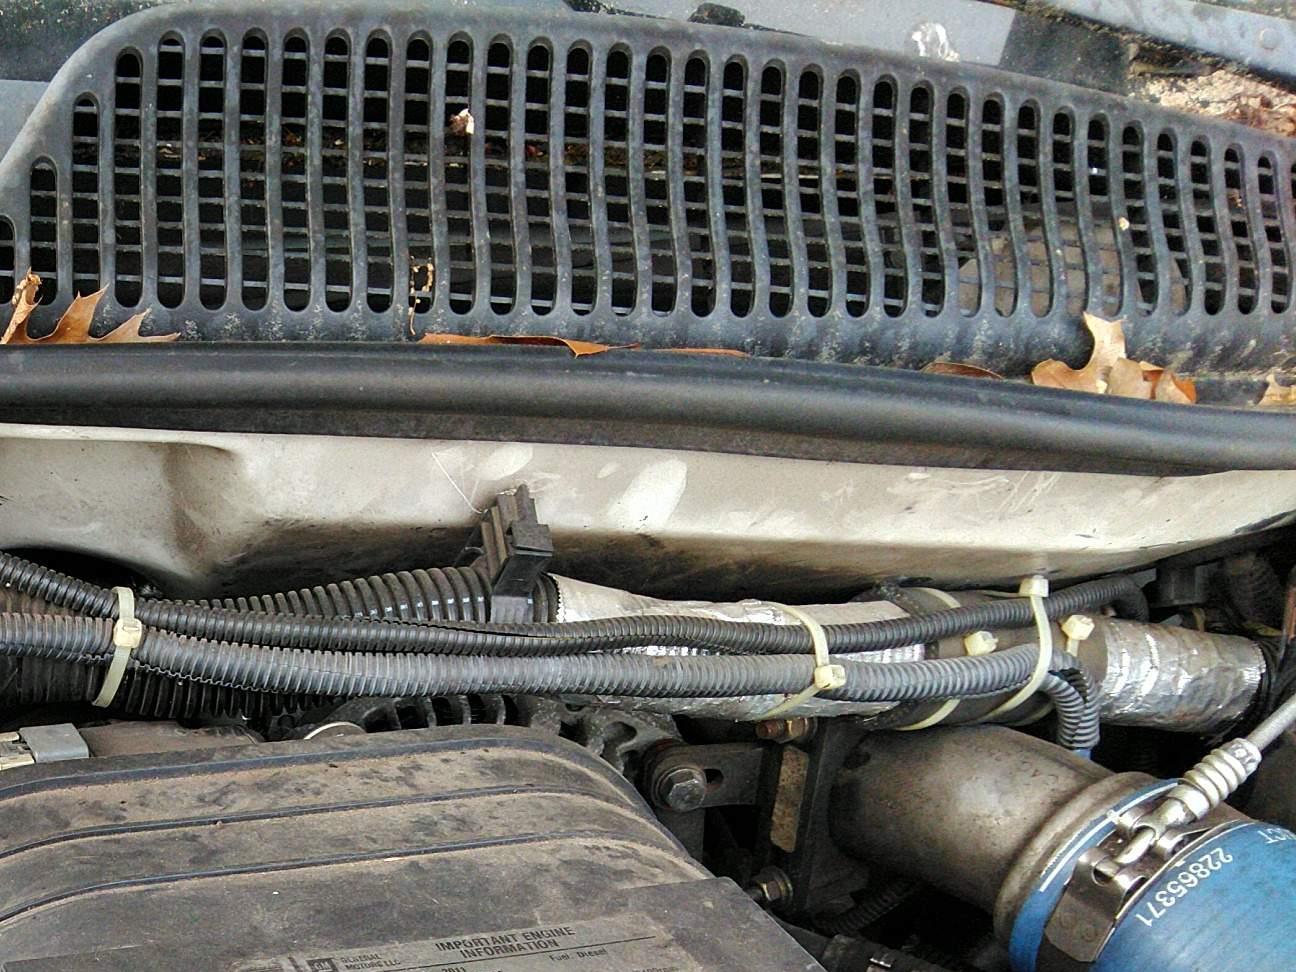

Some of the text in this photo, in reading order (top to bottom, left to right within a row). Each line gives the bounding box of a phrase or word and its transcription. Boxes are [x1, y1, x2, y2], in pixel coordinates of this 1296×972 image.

[1135, 847, 1233, 928] 22865371
[434, 927, 576, 950] IMPORTANT ENGINE
[459, 939, 560, 957] INFORMATION
